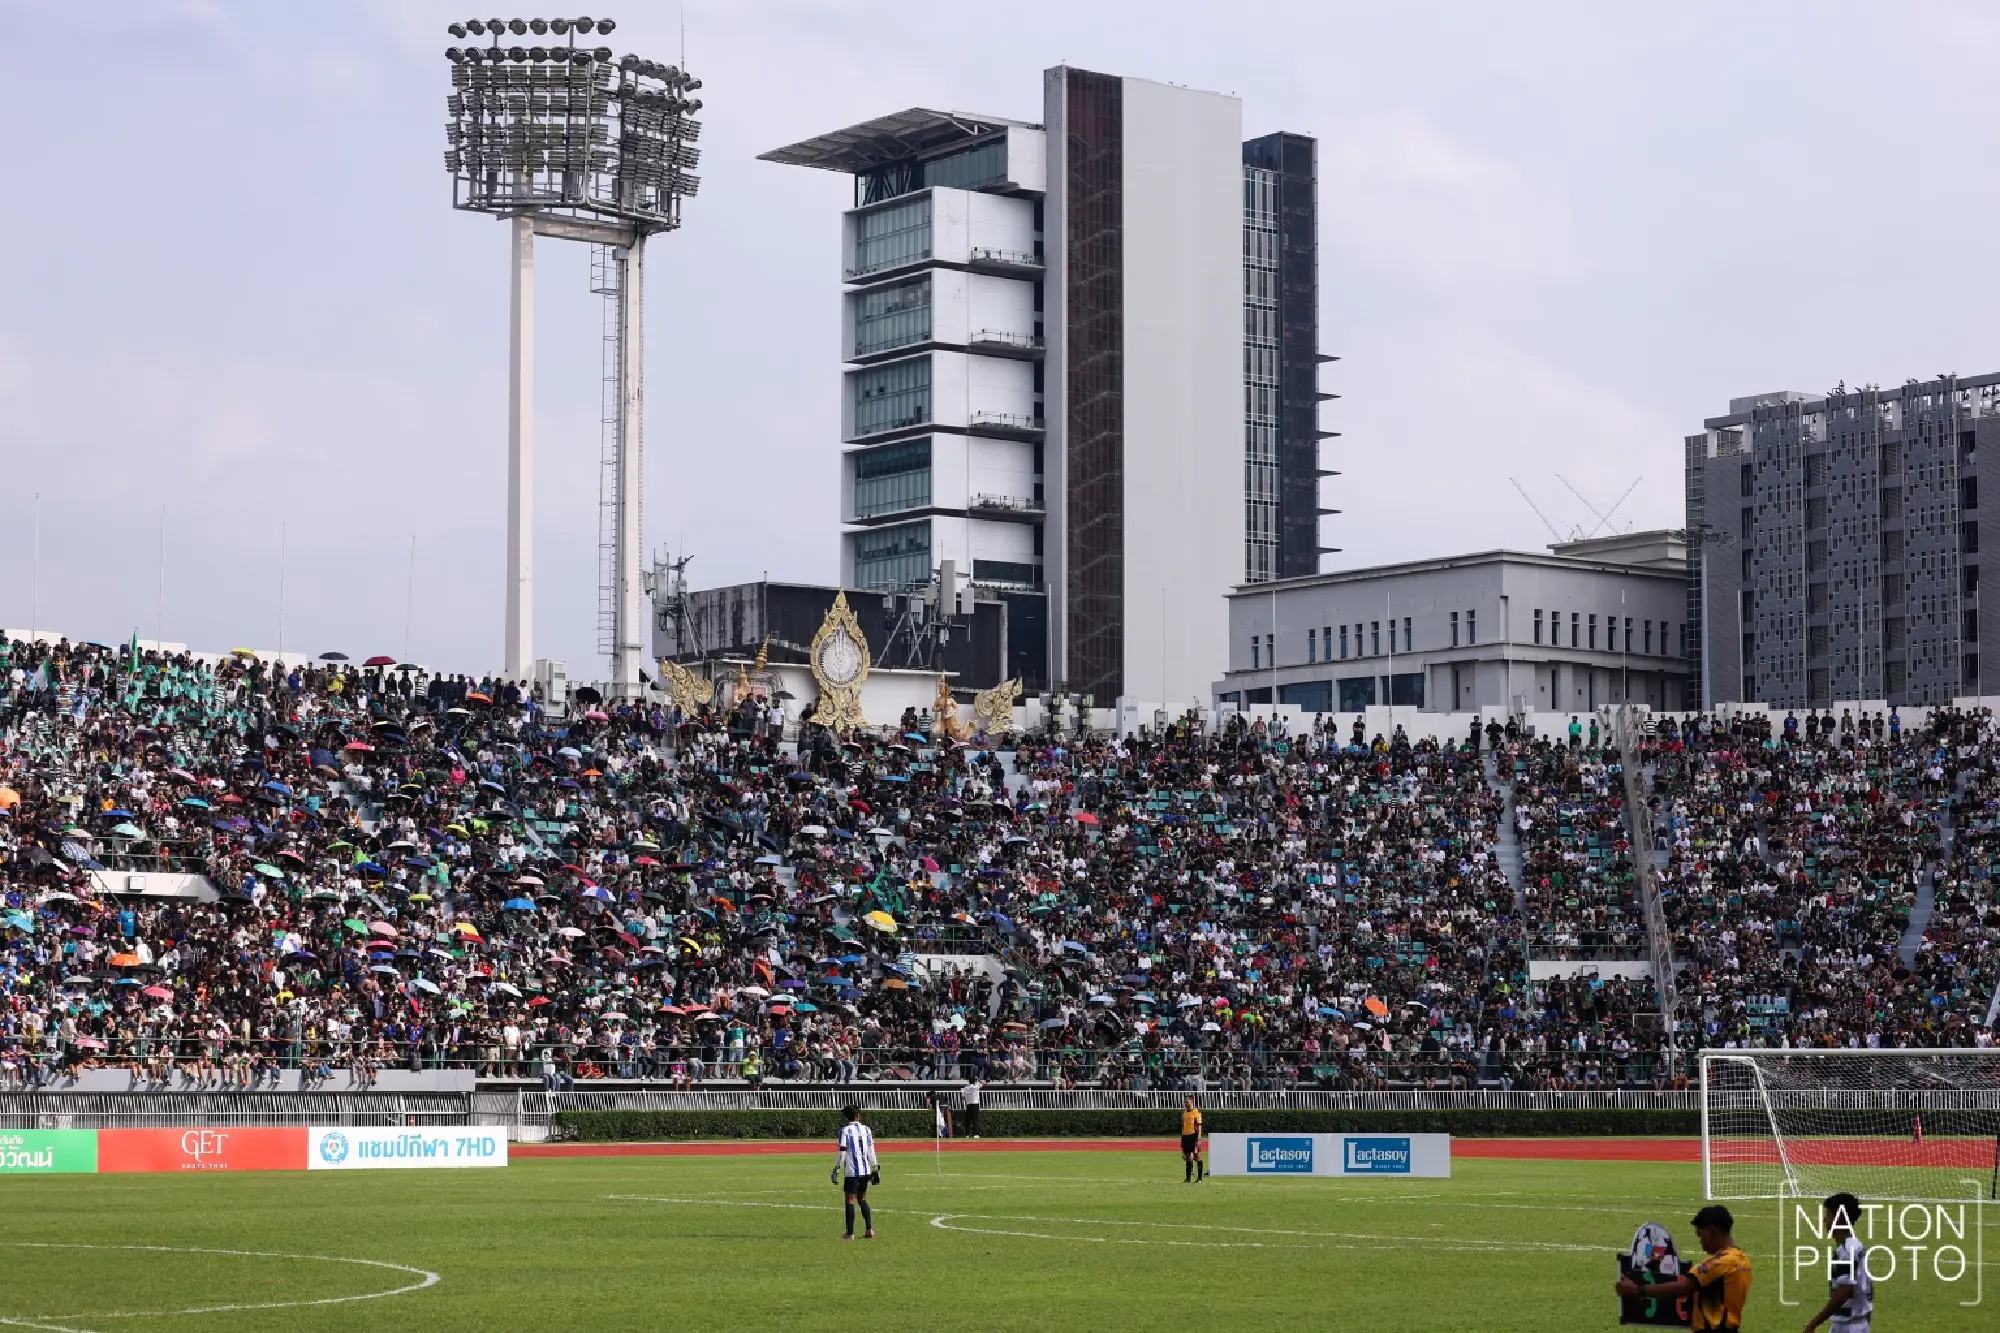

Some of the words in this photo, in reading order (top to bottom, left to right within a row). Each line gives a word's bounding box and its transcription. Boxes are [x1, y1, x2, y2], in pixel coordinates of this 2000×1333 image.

[181, 1130, 229, 1163] GET
[358, 1134, 449, 1158] แชมป์กีฬา
[455, 1137, 496, 1157] 7HD
[1250, 1141, 1311, 1169] Lactasoy
[1347, 1142, 1409, 1169] Lactasoy
